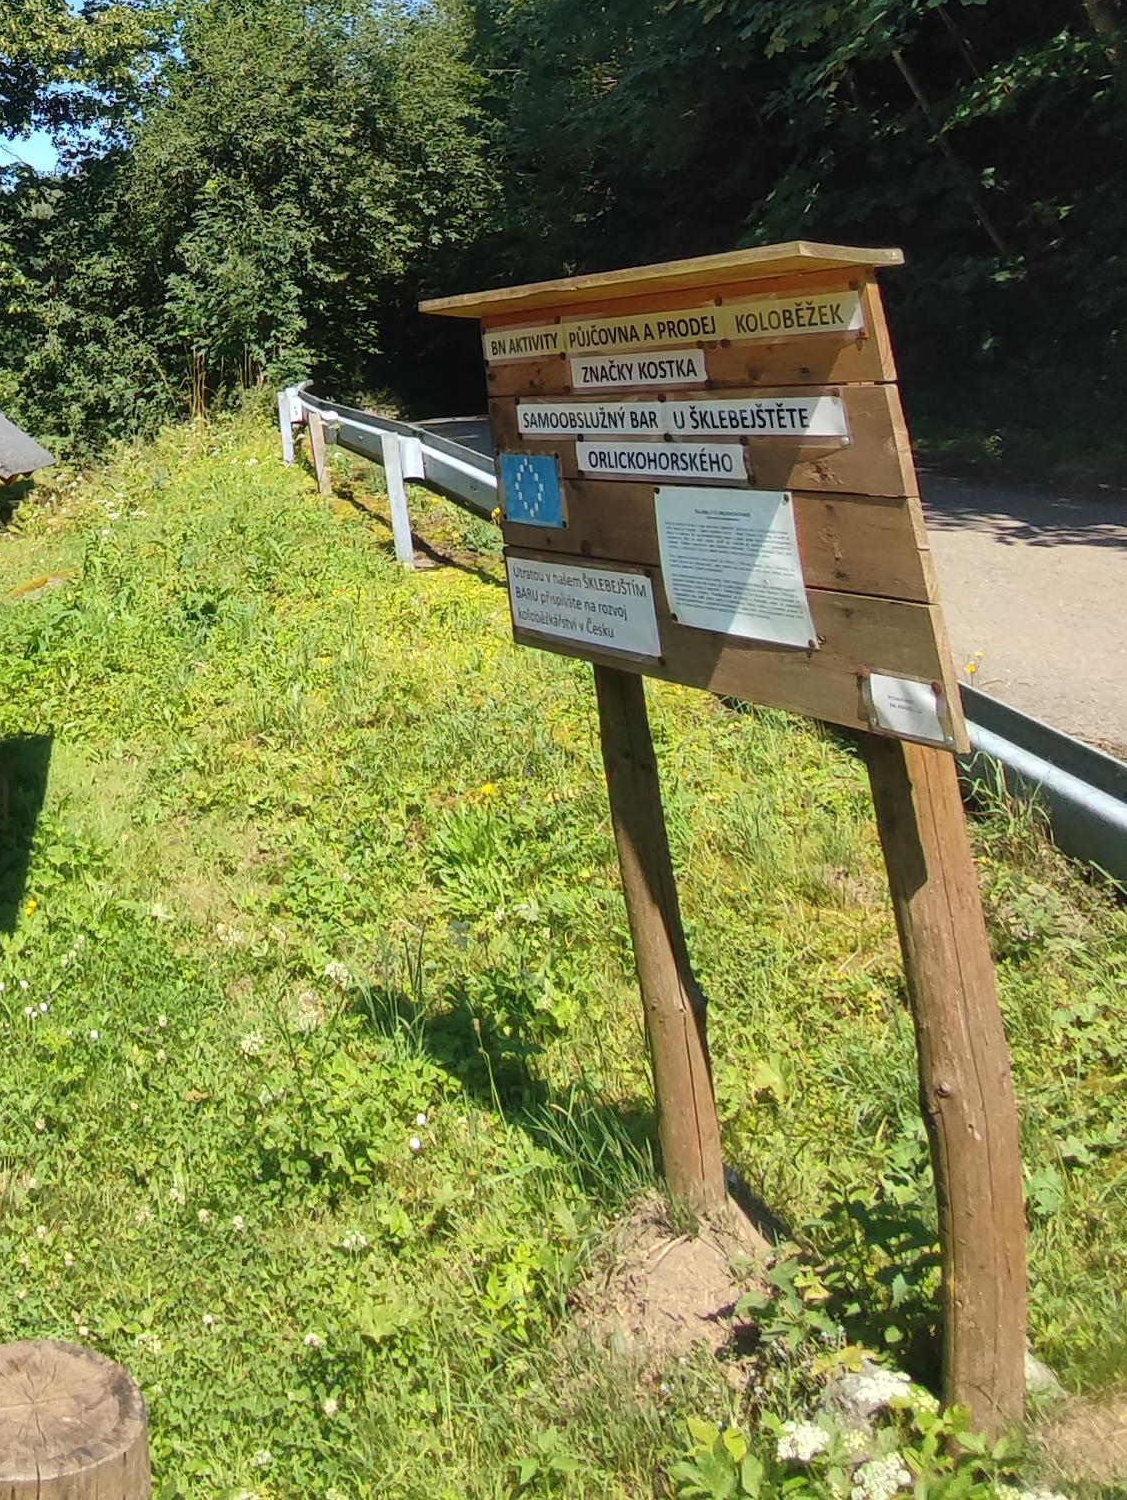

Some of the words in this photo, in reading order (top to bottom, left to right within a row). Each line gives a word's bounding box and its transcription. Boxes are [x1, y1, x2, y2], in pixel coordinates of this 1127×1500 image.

[491, 340, 507, 356] BN
[509, 333, 559, 354] AKTIVITY
[569, 324, 641, 348] PŮJČOVNA
[644, 323, 655, 341] A
[657, 315, 716, 340] PRODEJ
[735, 301, 845, 334] KOLOBĚŽEK
[581, 360, 634, 384] ZNAČKY
[638, 358, 698, 380] KOSTKA
[523, 406, 626, 429] SAMOOBSLUŽNÝ
[630, 411, 659, 429] BAR
[673, 410, 685, 430] U
[689, 403, 810, 430] ŠKLEBEJŠTĚTE
[588, 448, 733, 473] ORLICKOHORSKÉHO
[512, 565, 544, 582] Utratou
[552, 573, 582, 588] našem
[582, 573, 647, 598] ŠKLEBEJŠTÍM
[515, 586, 538, 602] BARU
[584, 601, 596, 612] na
[598, 604, 628, 621] rozvoj
[586, 617, 614, 638] Česku
